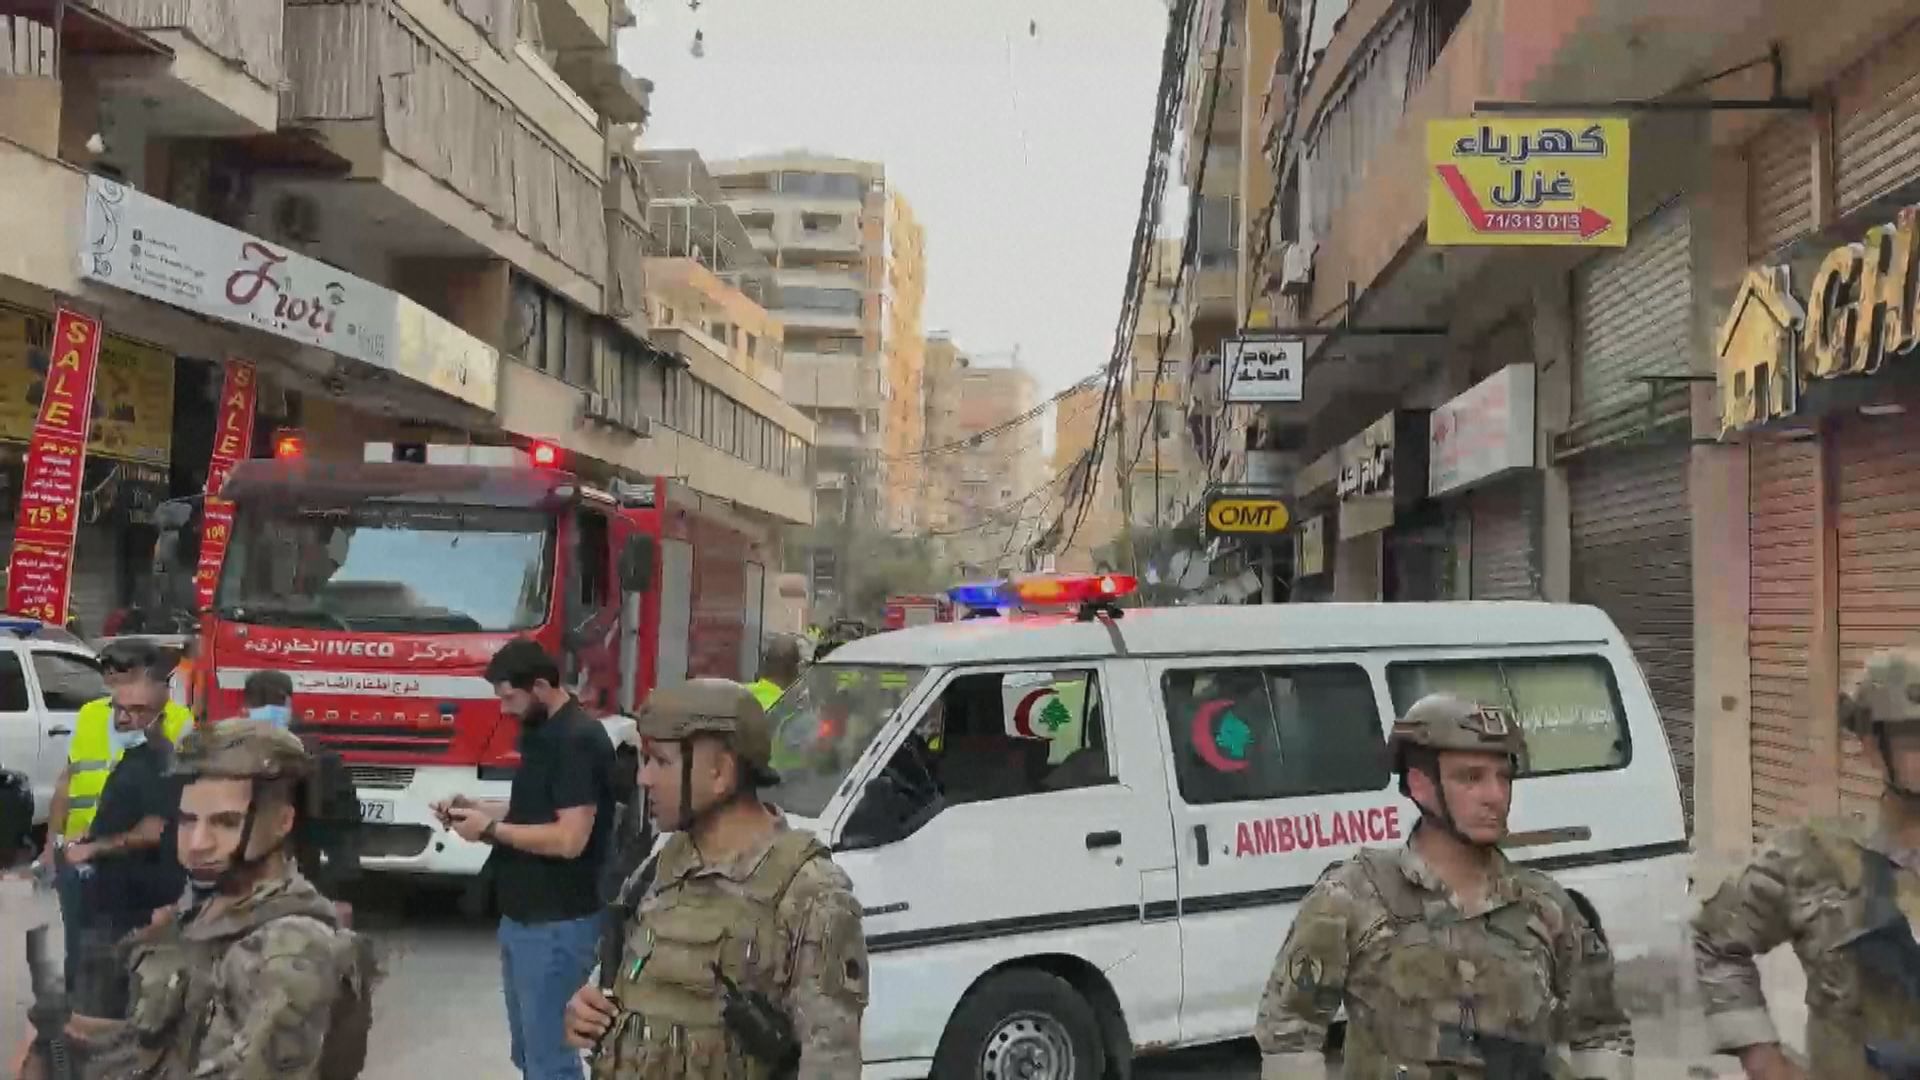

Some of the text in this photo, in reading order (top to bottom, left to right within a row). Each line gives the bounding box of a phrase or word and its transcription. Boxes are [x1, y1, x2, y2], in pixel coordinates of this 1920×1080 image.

[1453, 125, 1608, 164] كهرباء
[1490, 168, 1576, 207] غزل
[44, 320, 90, 426] SALE
[218, 367, 252, 454] SALE
[27, 506, 52, 524] 75
[1218, 505, 1281, 528] OMT
[326, 639, 395, 658] IVECO
[1236, 806, 1401, 859] AMBULANCE
